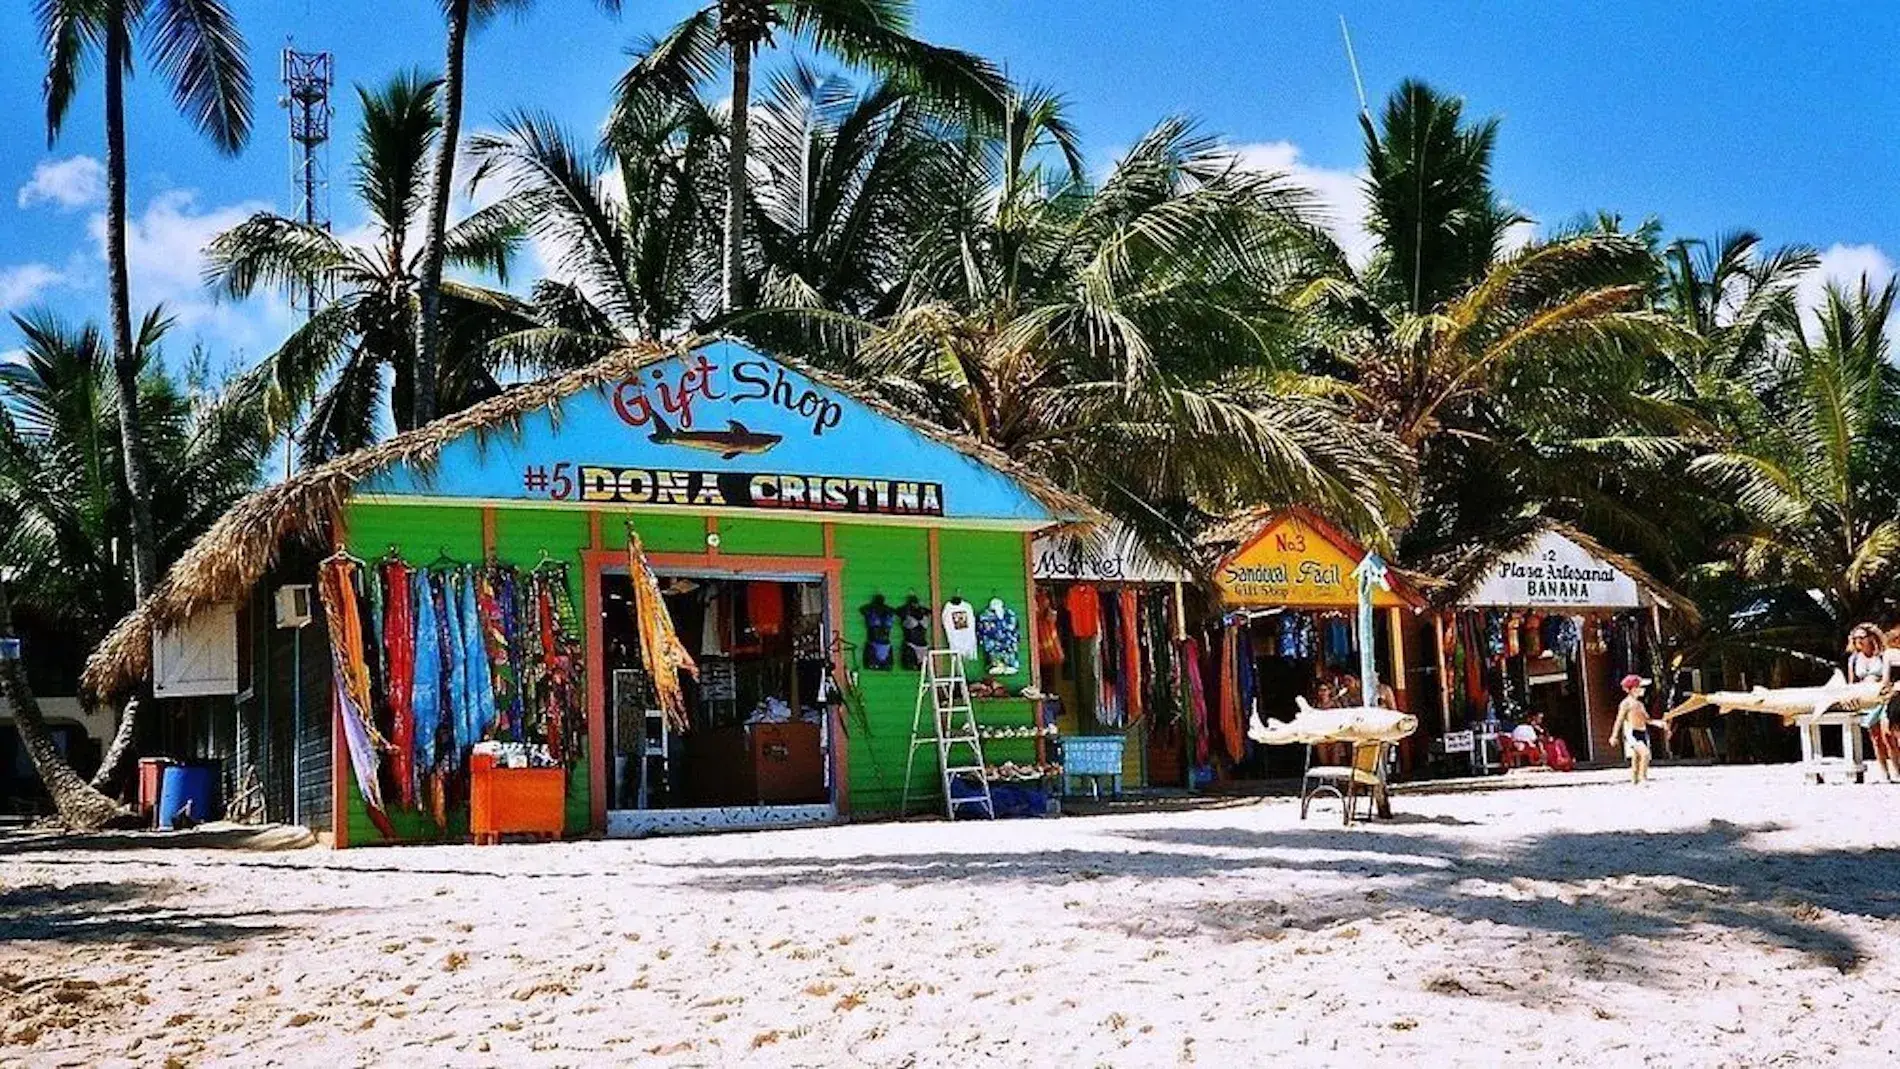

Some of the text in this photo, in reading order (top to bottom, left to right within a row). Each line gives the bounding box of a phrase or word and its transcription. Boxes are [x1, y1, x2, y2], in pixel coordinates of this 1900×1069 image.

[613, 355, 842, 436] Gift Shop
[524, 462, 942, 514] #5 DONA CRISTINA
[1527, 581, 1590, 598] BANANA
